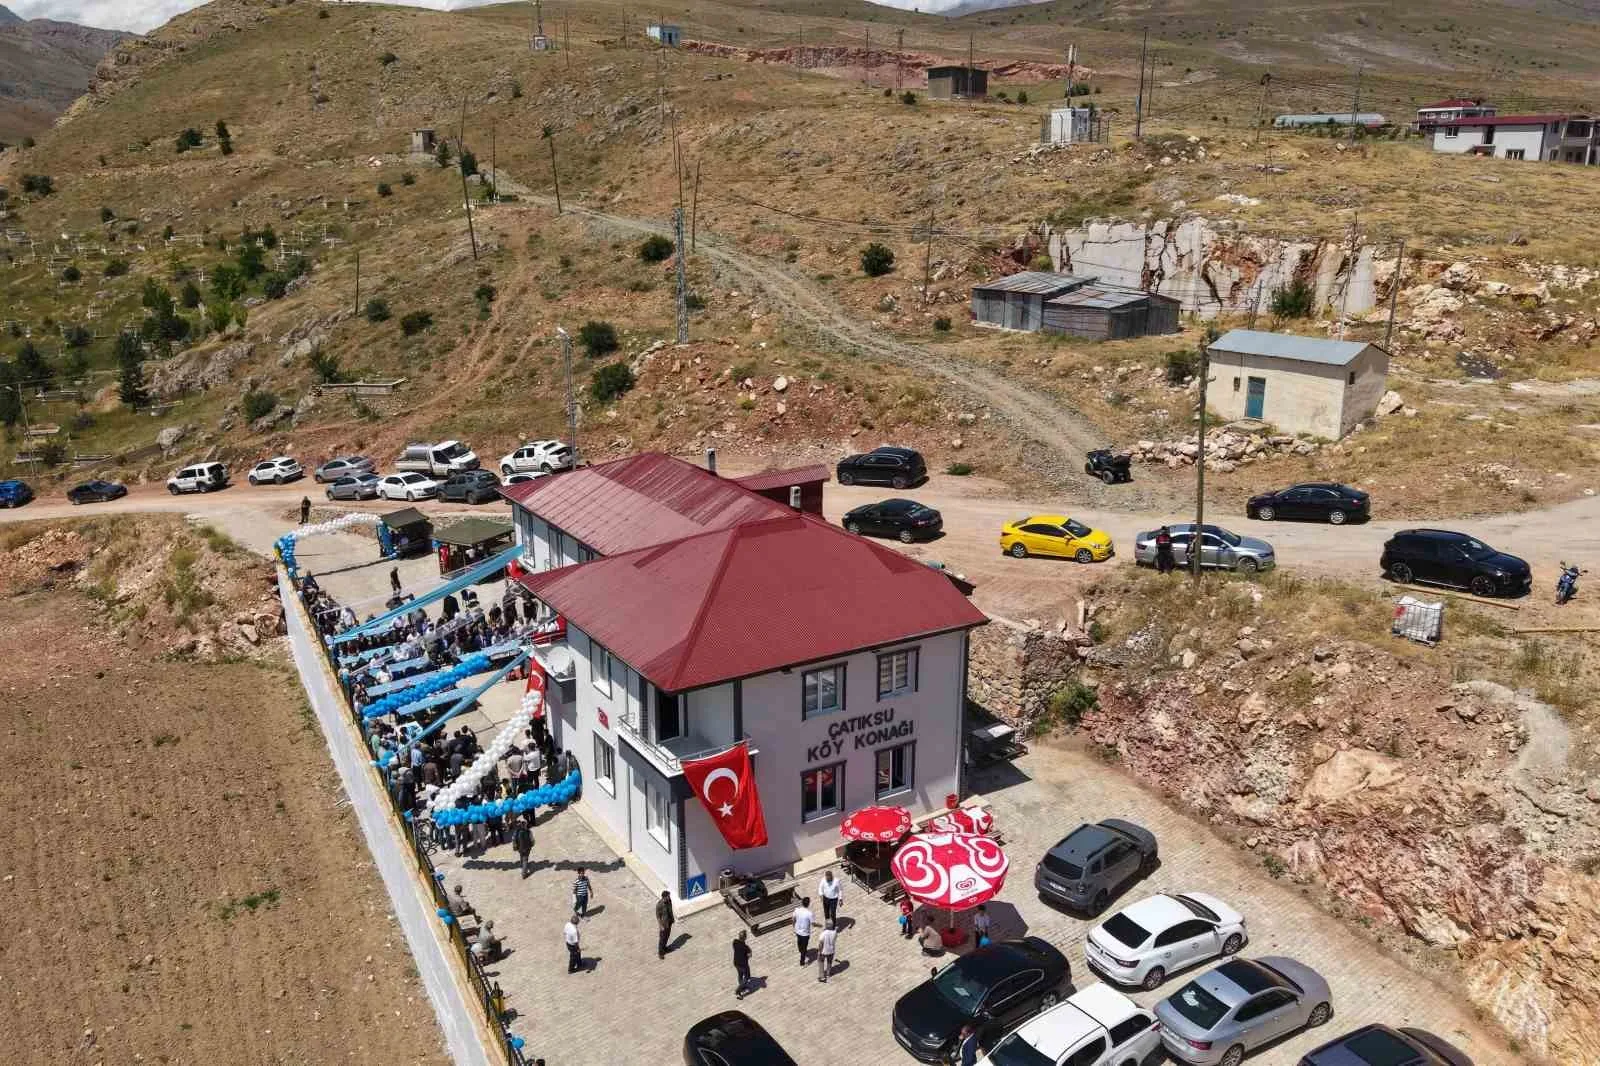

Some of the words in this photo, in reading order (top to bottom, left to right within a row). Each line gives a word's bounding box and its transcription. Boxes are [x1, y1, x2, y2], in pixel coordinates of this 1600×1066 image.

[807, 739, 844, 763] KÖY
[854, 719, 914, 750] KONAĞI
[828, 708, 894, 741] ÇATIKSU
